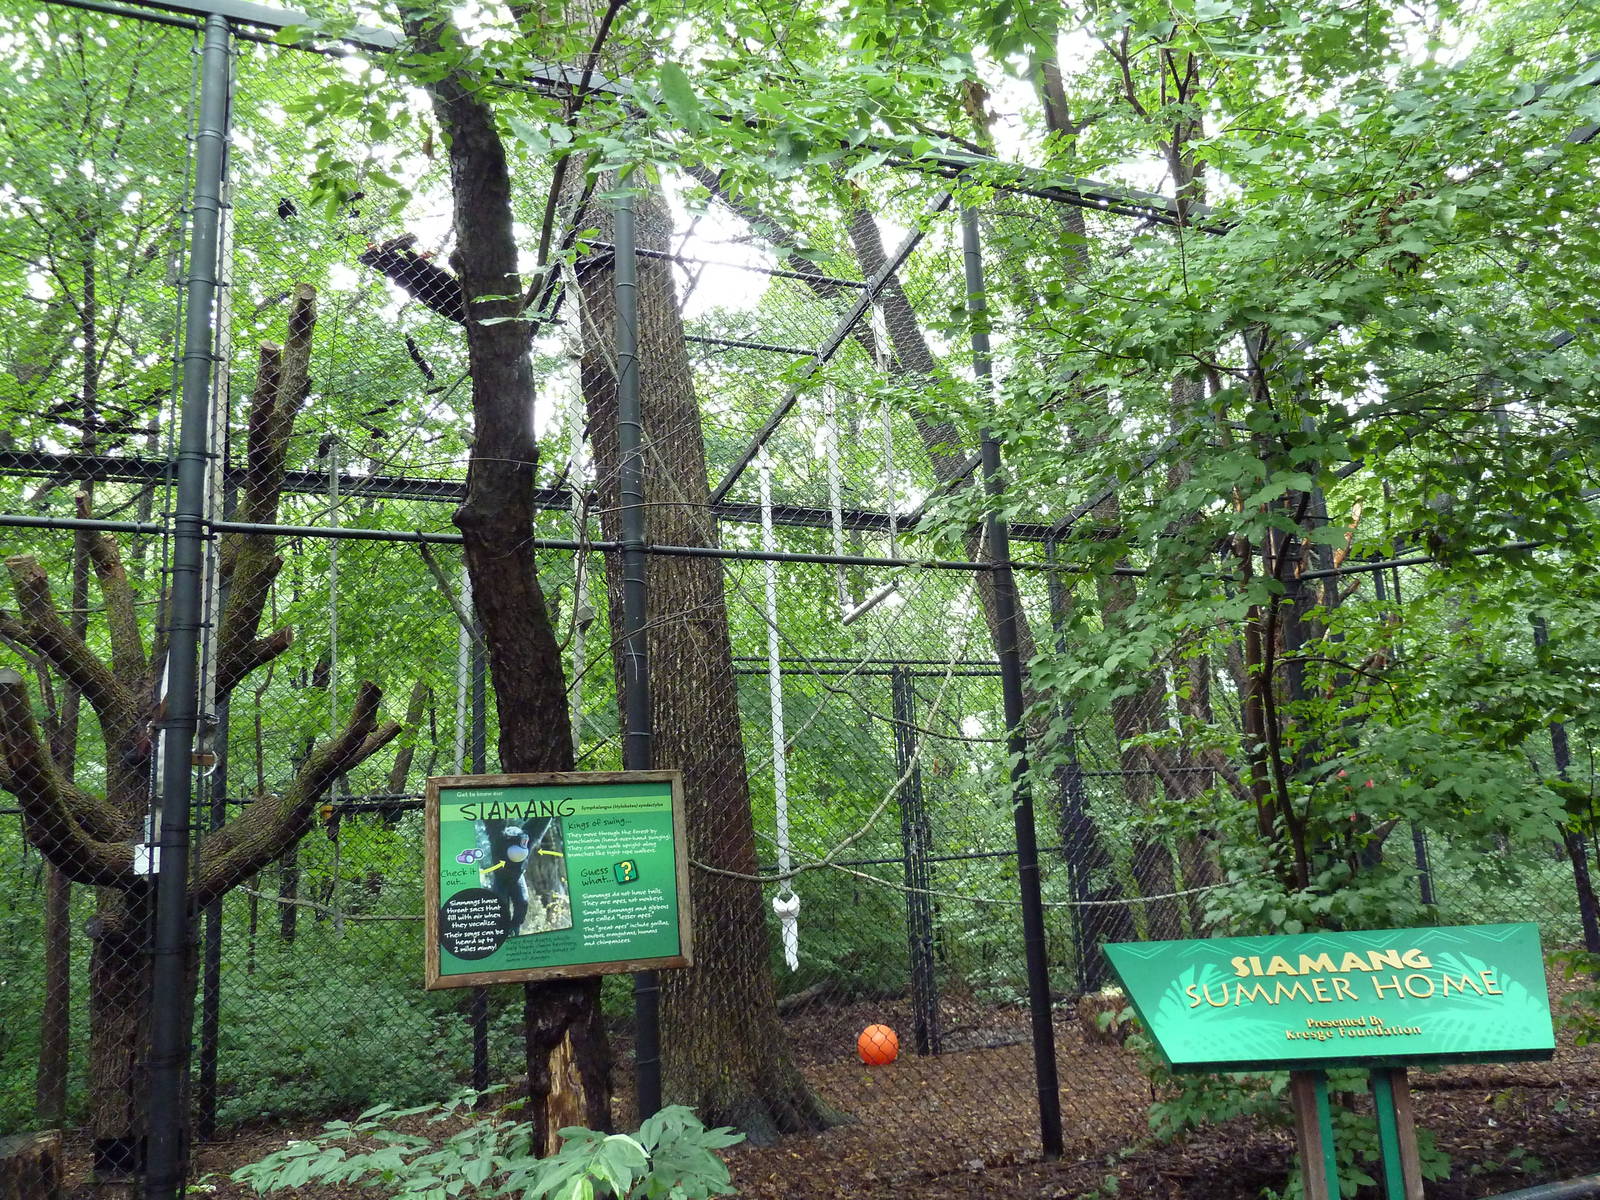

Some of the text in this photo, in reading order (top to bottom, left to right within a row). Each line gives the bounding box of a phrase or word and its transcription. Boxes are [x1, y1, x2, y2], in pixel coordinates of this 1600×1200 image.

[460, 798, 575, 821] SIAMANG
[568, 817, 632, 831] Kings of swing...
[441, 868, 467, 878] Check
[581, 867, 608, 877] Guess
[581, 876, 614, 887] what...
[582, 908, 606, 916] Smaller
[455, 938, 476, 946] heard
[477, 944, 497, 952] away!
[1231, 947, 1432, 978] SIAMANG
[1185, 970, 1503, 1007] SUMMER HOME
[1306, 1016, 1385, 1030] Presented By
[1285, 1024, 1422, 1042] Kresge Foundation
